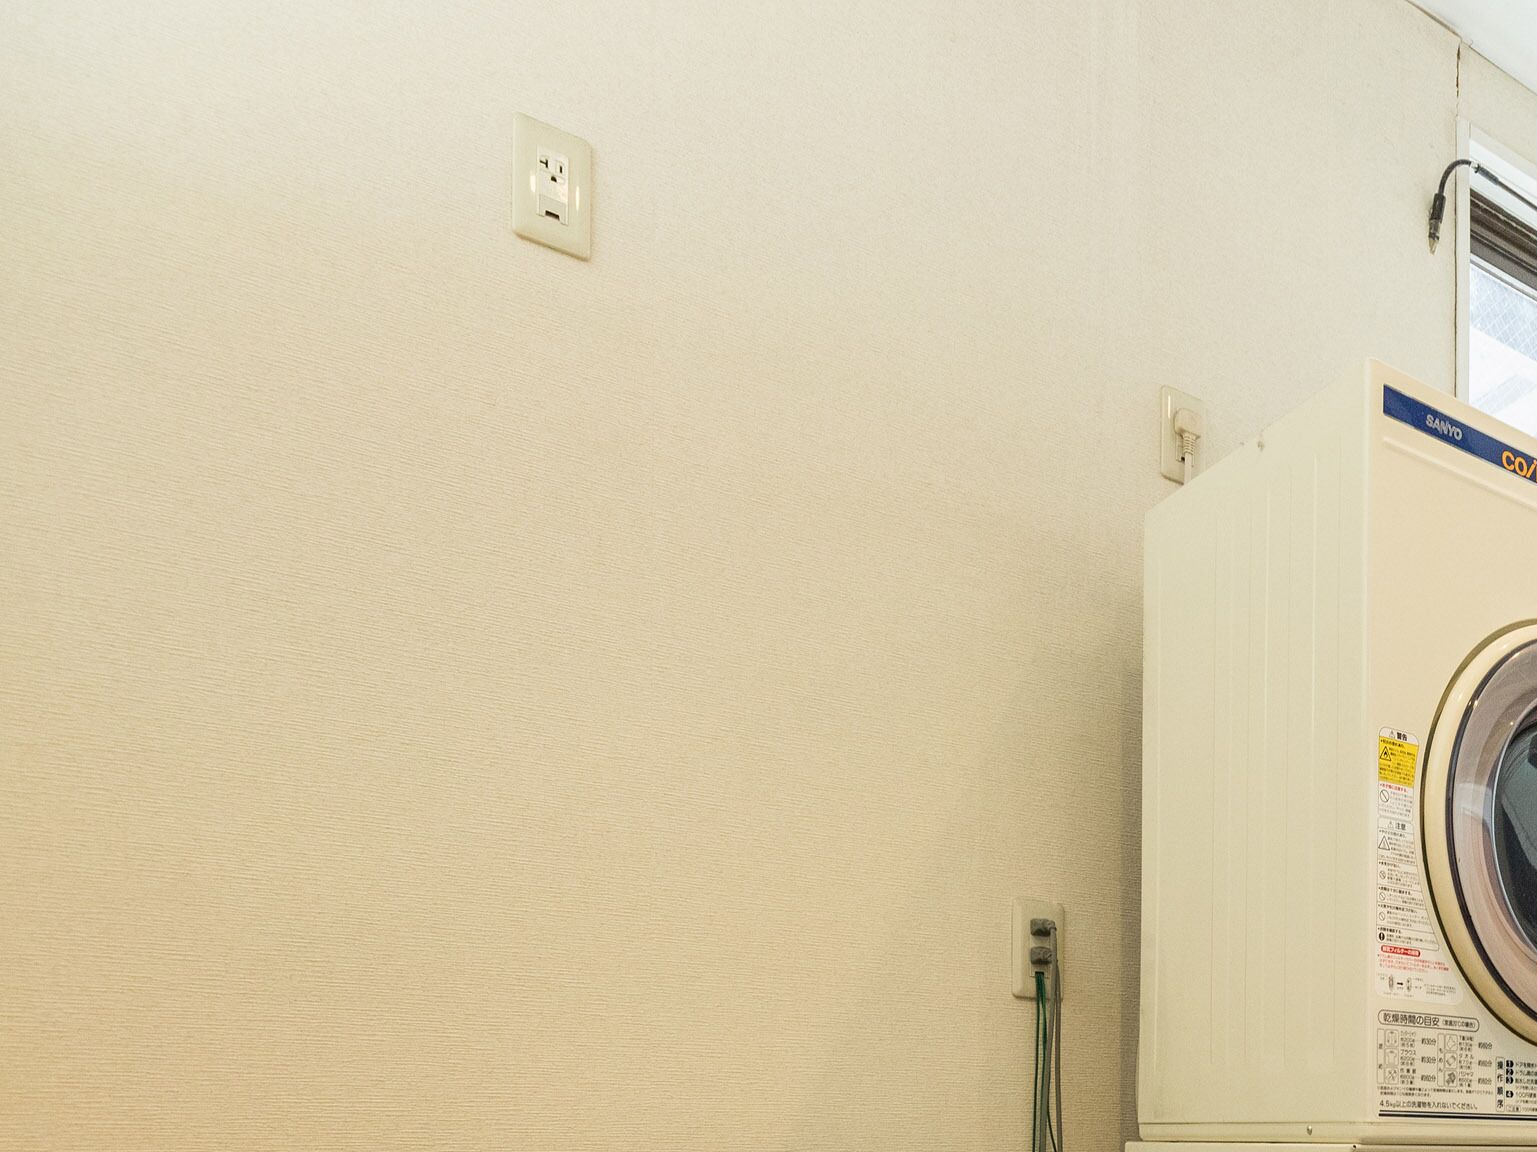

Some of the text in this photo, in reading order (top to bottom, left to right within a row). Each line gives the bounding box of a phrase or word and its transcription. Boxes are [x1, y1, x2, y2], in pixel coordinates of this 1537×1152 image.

[1426, 414, 1463, 441] SANYO
[1383, 1012, 1440, 1027] 乾燥時間の目安
